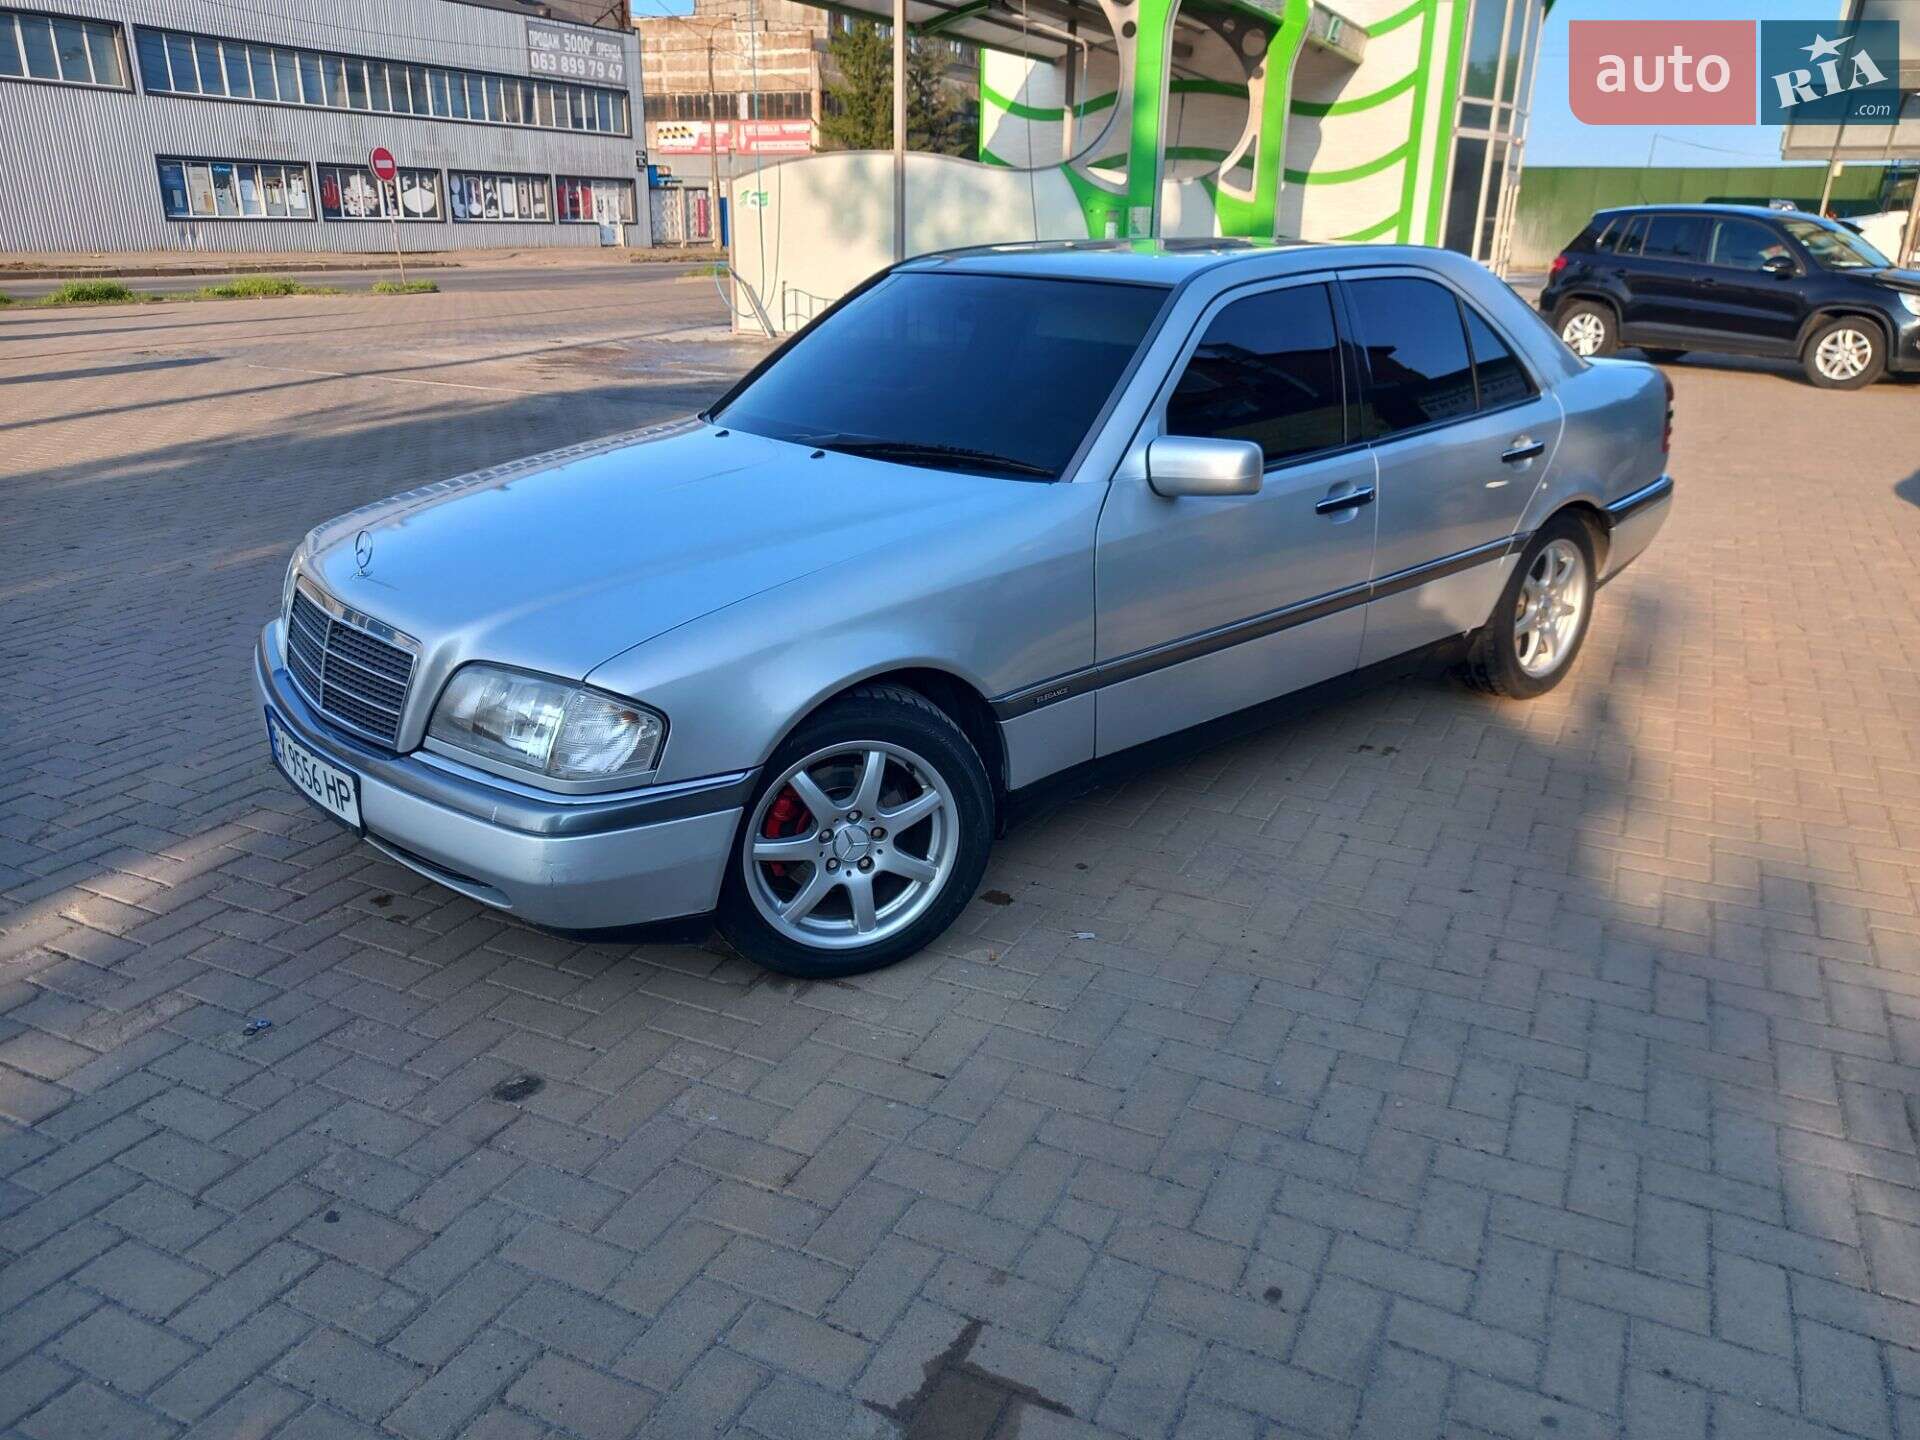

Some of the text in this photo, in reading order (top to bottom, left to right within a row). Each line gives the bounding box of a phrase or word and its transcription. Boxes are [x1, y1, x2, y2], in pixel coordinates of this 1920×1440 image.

[530, 51, 623, 80] 063 899 79 47
[323, 770, 351, 812] HP
